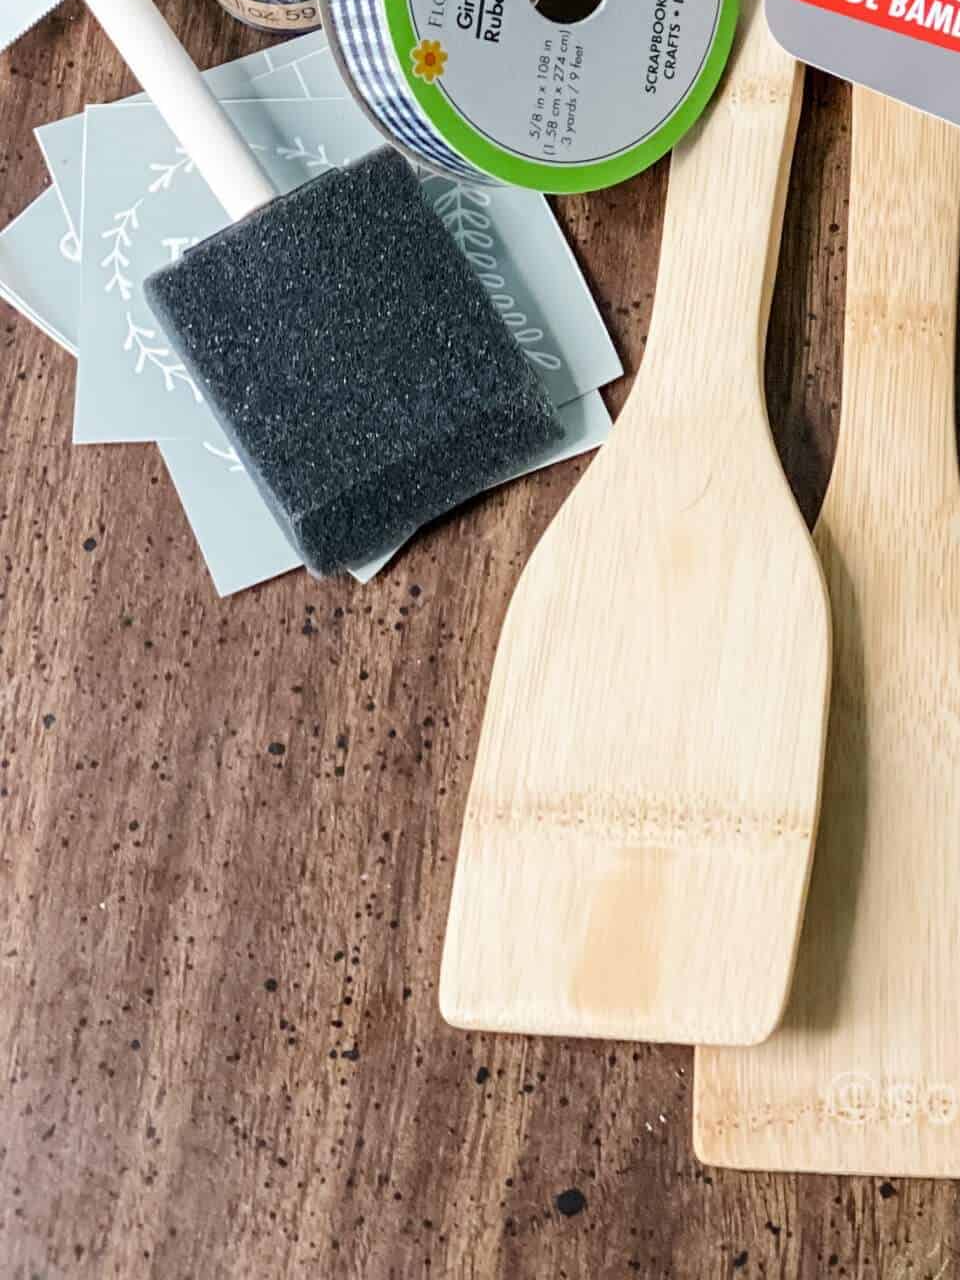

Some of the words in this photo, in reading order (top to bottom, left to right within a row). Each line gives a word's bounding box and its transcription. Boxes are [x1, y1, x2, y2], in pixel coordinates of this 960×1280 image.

[544, 39, 553, 52] in
[663, 22, 682, 81] CRAFTS
[536, 55, 551, 79] 108
[553, 56, 566, 82] 274
[569, 71, 580, 81] 9
[536, 97, 545, 109] in
[551, 98, 561, 117] cm
[528, 112, 543, 140] 5/8
[565, 98, 577, 134] yards
[561, 136, 572, 145] 3
